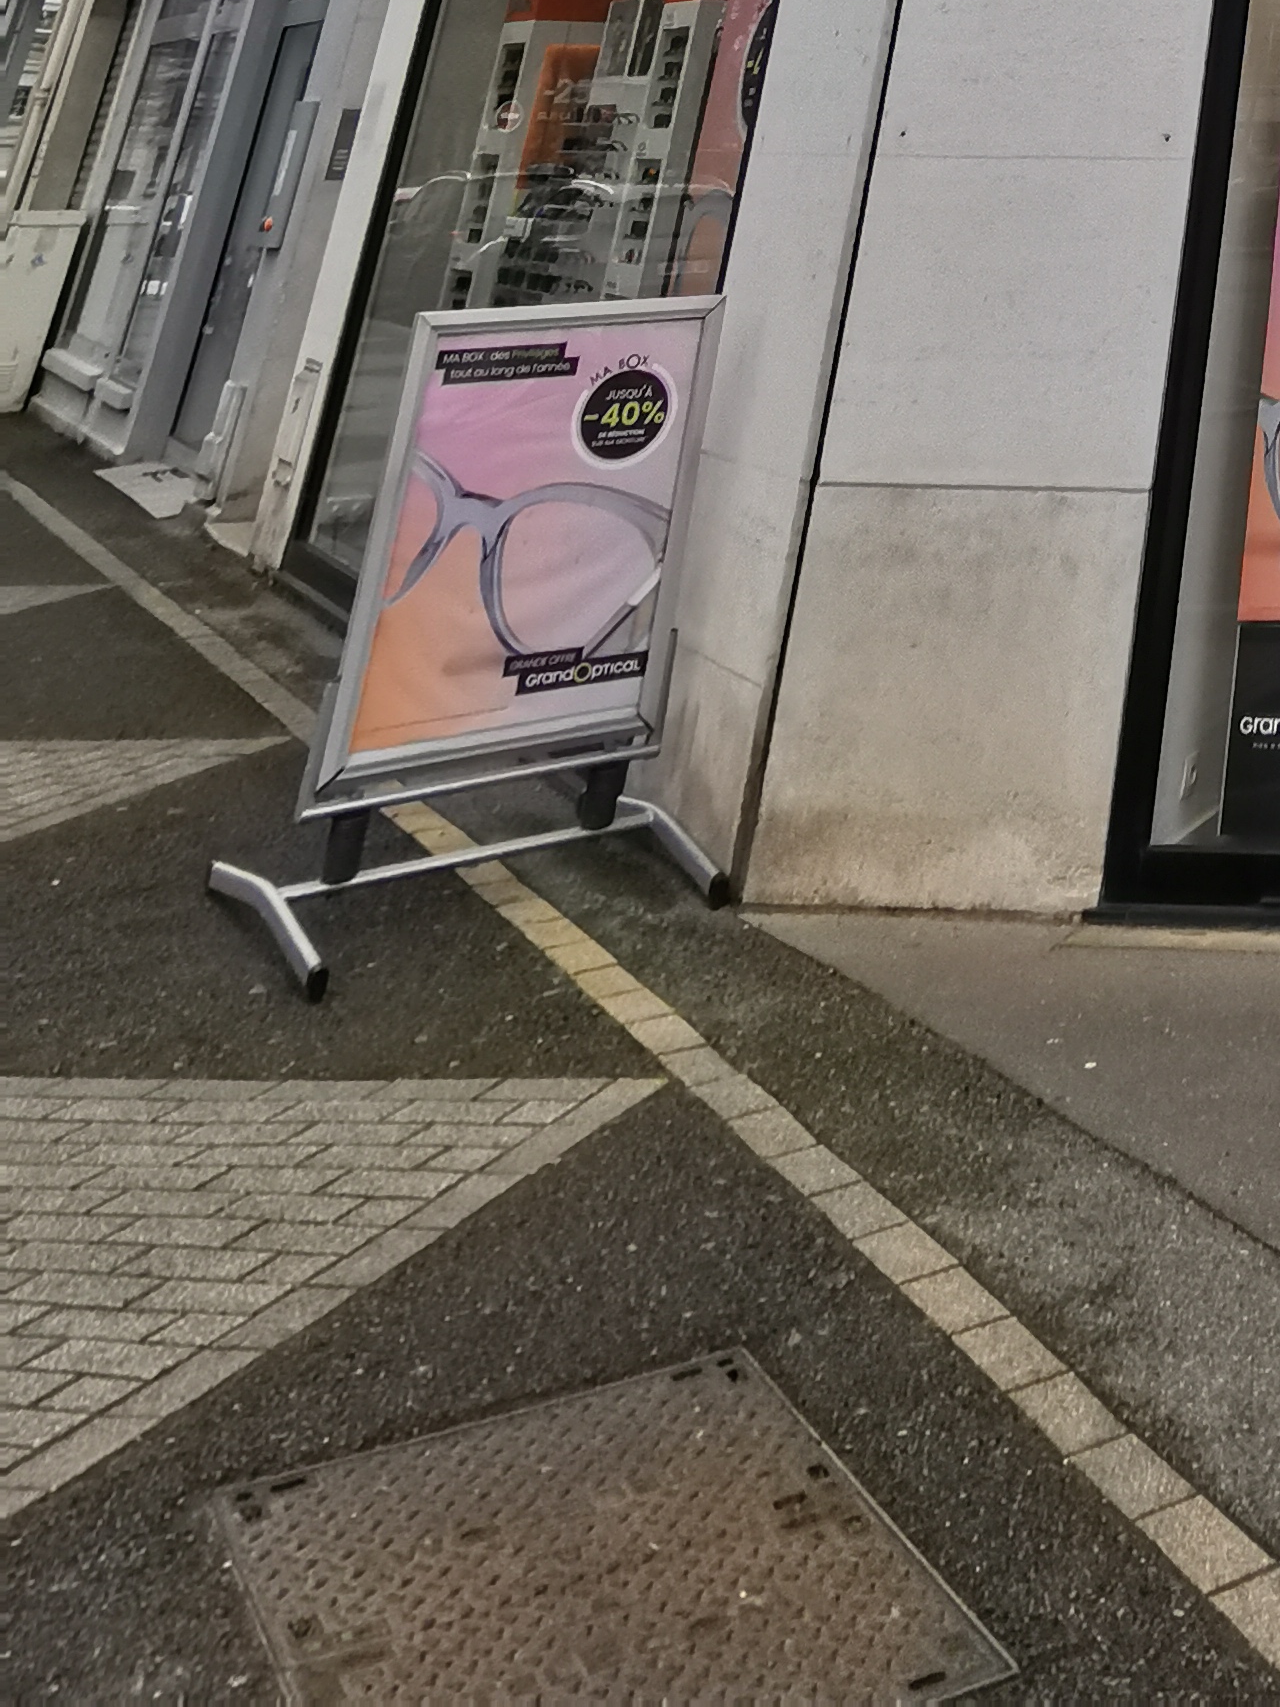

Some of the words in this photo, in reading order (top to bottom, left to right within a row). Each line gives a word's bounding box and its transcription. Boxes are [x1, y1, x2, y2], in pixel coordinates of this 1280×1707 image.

[491, 365, 515, 380] long
[589, 365, 613, 386] MA
[618, 354, 651, 371] BOX
[583, 399, 665, 428] -40%
